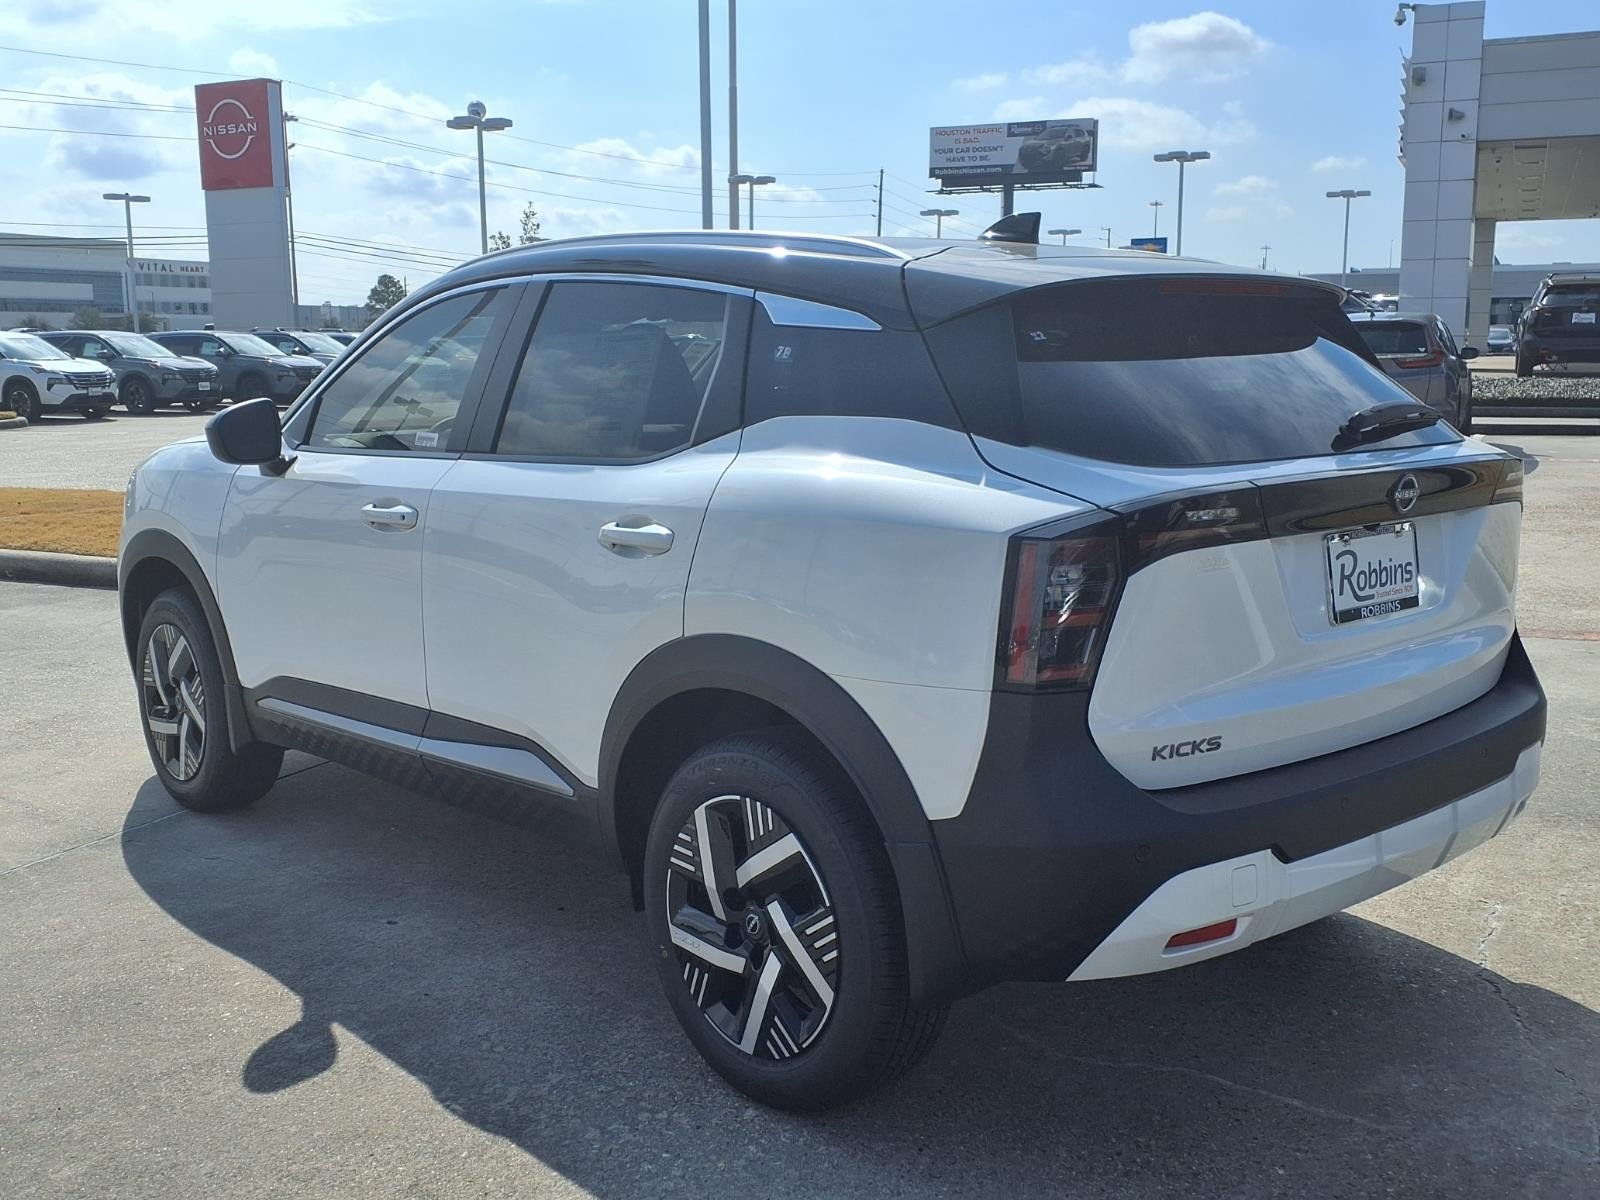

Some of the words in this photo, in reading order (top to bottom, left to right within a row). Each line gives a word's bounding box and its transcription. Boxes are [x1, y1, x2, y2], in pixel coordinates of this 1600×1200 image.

[203, 122, 257, 136] NISSAN
[935, 129, 971, 137] HOUSTON
[973, 127, 1003, 135] TRAFFIC
[934, 147, 954, 155] YOUR
[955, 146, 971, 154] CAR
[972, 145, 1003, 153] DOESN'T
[934, 167, 1002, 175] RobbinsNissan.com
[138, 262, 175, 273] VITAL
[1335, 549, 1413, 602] Robbins
[1361, 600, 1401, 618] ROBBINS
[1151, 735, 1222, 761] KICKS
